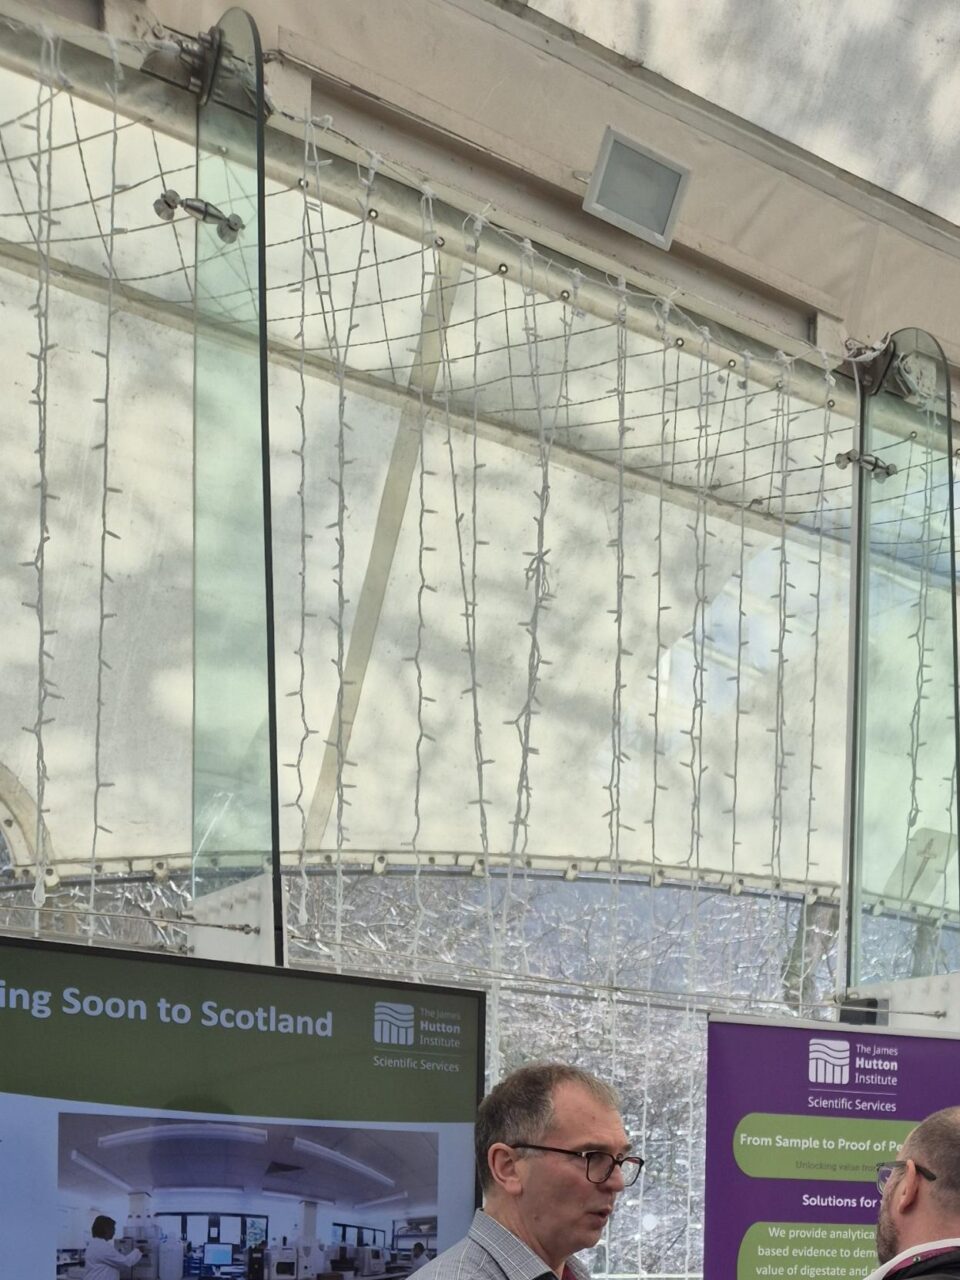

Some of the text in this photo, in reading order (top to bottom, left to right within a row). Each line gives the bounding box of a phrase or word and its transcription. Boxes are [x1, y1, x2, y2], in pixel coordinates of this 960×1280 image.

[62, 987, 147, 1020] Soon
[157, 998, 191, 1024] to
[201, 1001, 333, 1037] Scotland
[421, 1008, 436, 1017] The
[420, 1021, 460, 1033] Hutton
[420, 1035, 460, 1048] Institute
[856, 1044, 898, 1056] The James
[373, 1056, 459, 1072] Scientific Services
[856, 1057, 898, 1071] Hutton
[855, 1073, 897, 1086] Institute
[808, 1096, 896, 1112] Scientific Services
[740, 1134, 772, 1147] From
[775, 1135, 819, 1150] Sample
[823, 1139, 835, 1149] to
[838, 1139, 870, 1151] Proof
[873, 1141, 886, 1151] of
[802, 1194, 856, 1207] Solutions
[860, 1196, 877, 1207] for
[768, 1227, 876, 1241] We provide analytica
[758, 1245, 878, 1258] based evidence to dem
[756, 1265, 784, 1275] value
[787, 1265, 798, 1275] of
[800, 1266, 846, 1277] digestate
[849, 1266, 868, 1276] and
